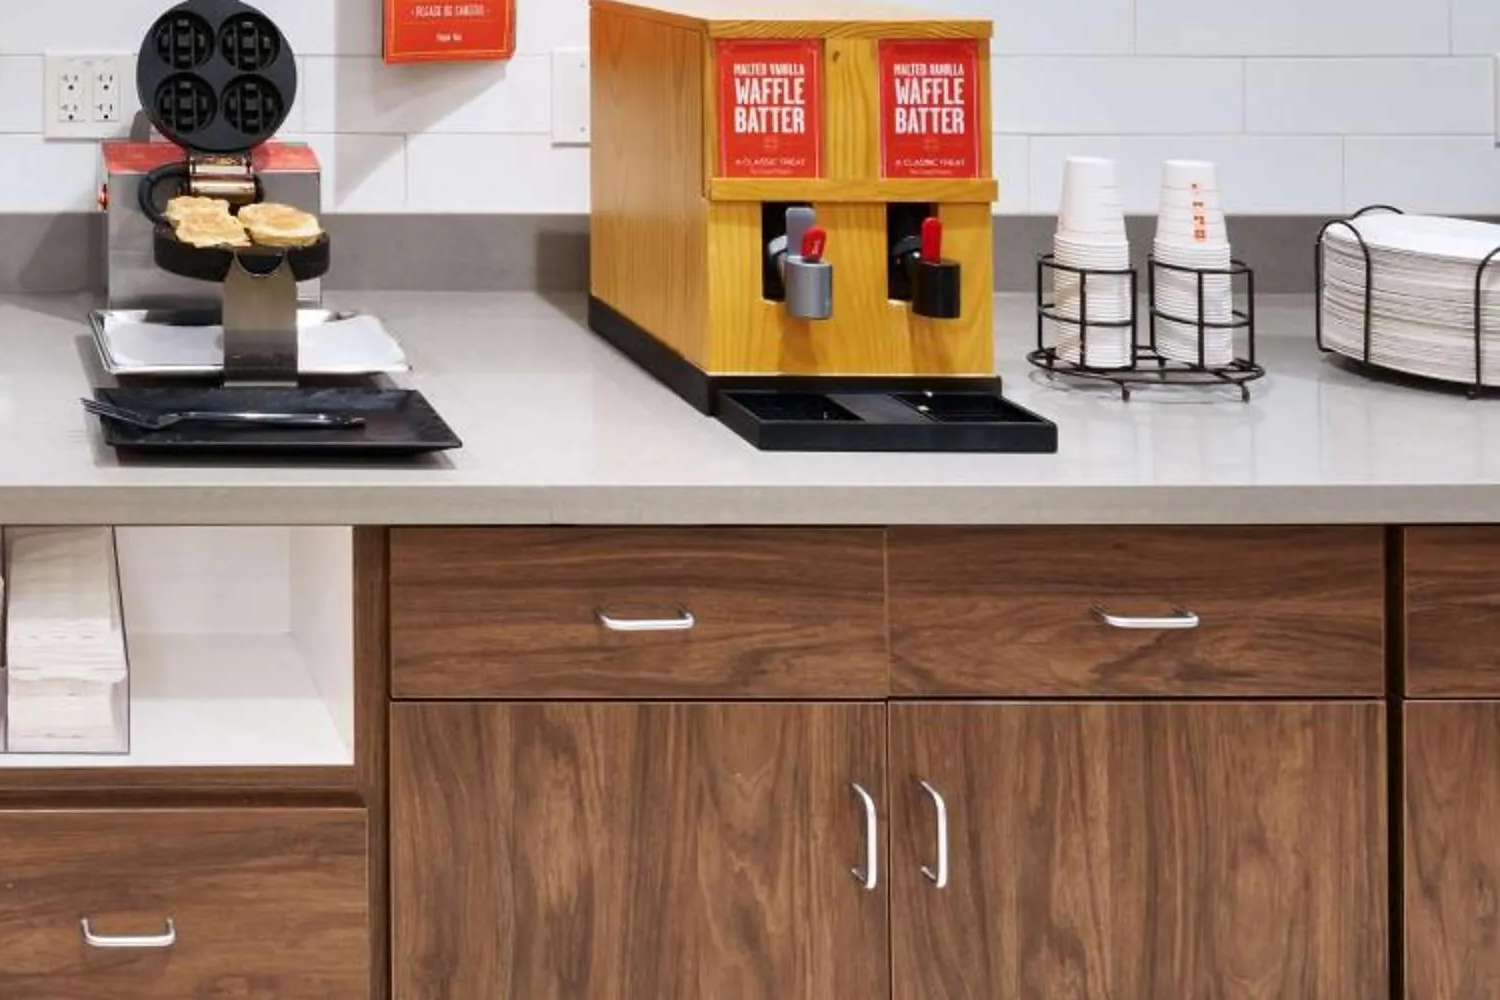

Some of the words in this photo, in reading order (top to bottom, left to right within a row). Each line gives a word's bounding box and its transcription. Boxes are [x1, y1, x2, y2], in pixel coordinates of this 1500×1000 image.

[735, 77, 805, 105] WAFFLE
[894, 77, 965, 105] WAFFLE
[735, 107, 805, 134] BATTER
[894, 107, 965, 134] BATTER
